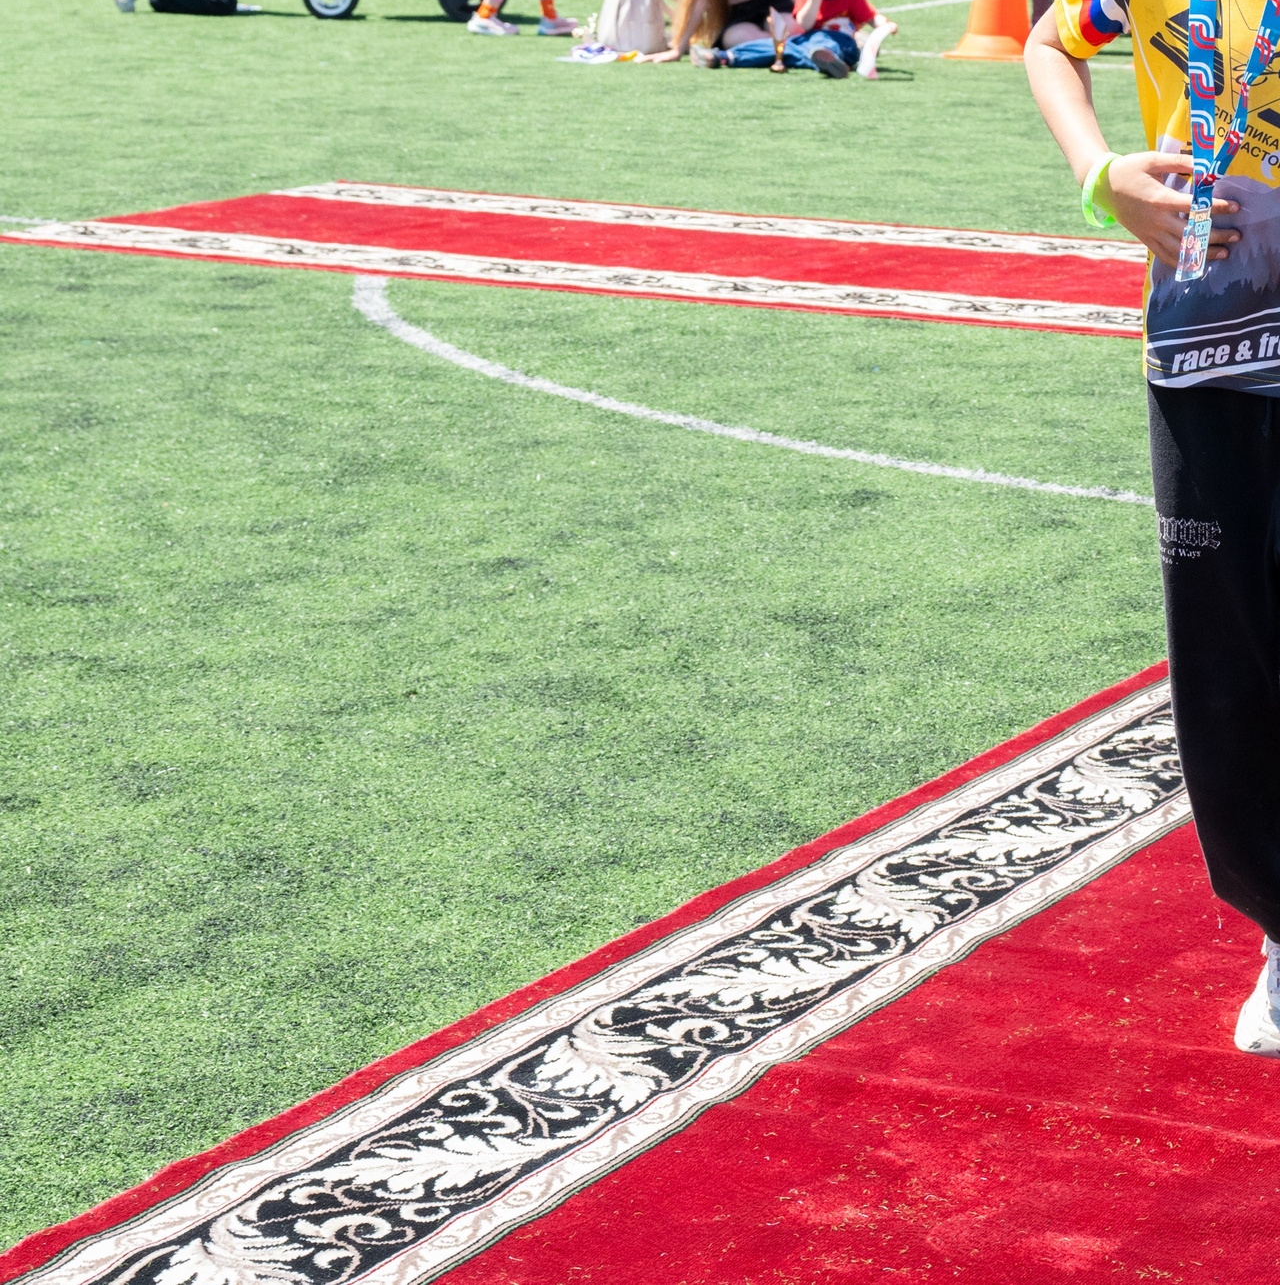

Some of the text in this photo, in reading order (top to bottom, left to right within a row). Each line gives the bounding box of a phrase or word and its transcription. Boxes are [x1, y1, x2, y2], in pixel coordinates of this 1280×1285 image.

[1214, 104, 1280, 151] СПУЛИКА
[1171, 344, 1231, 374] race
[1234, 339, 1254, 362] &
